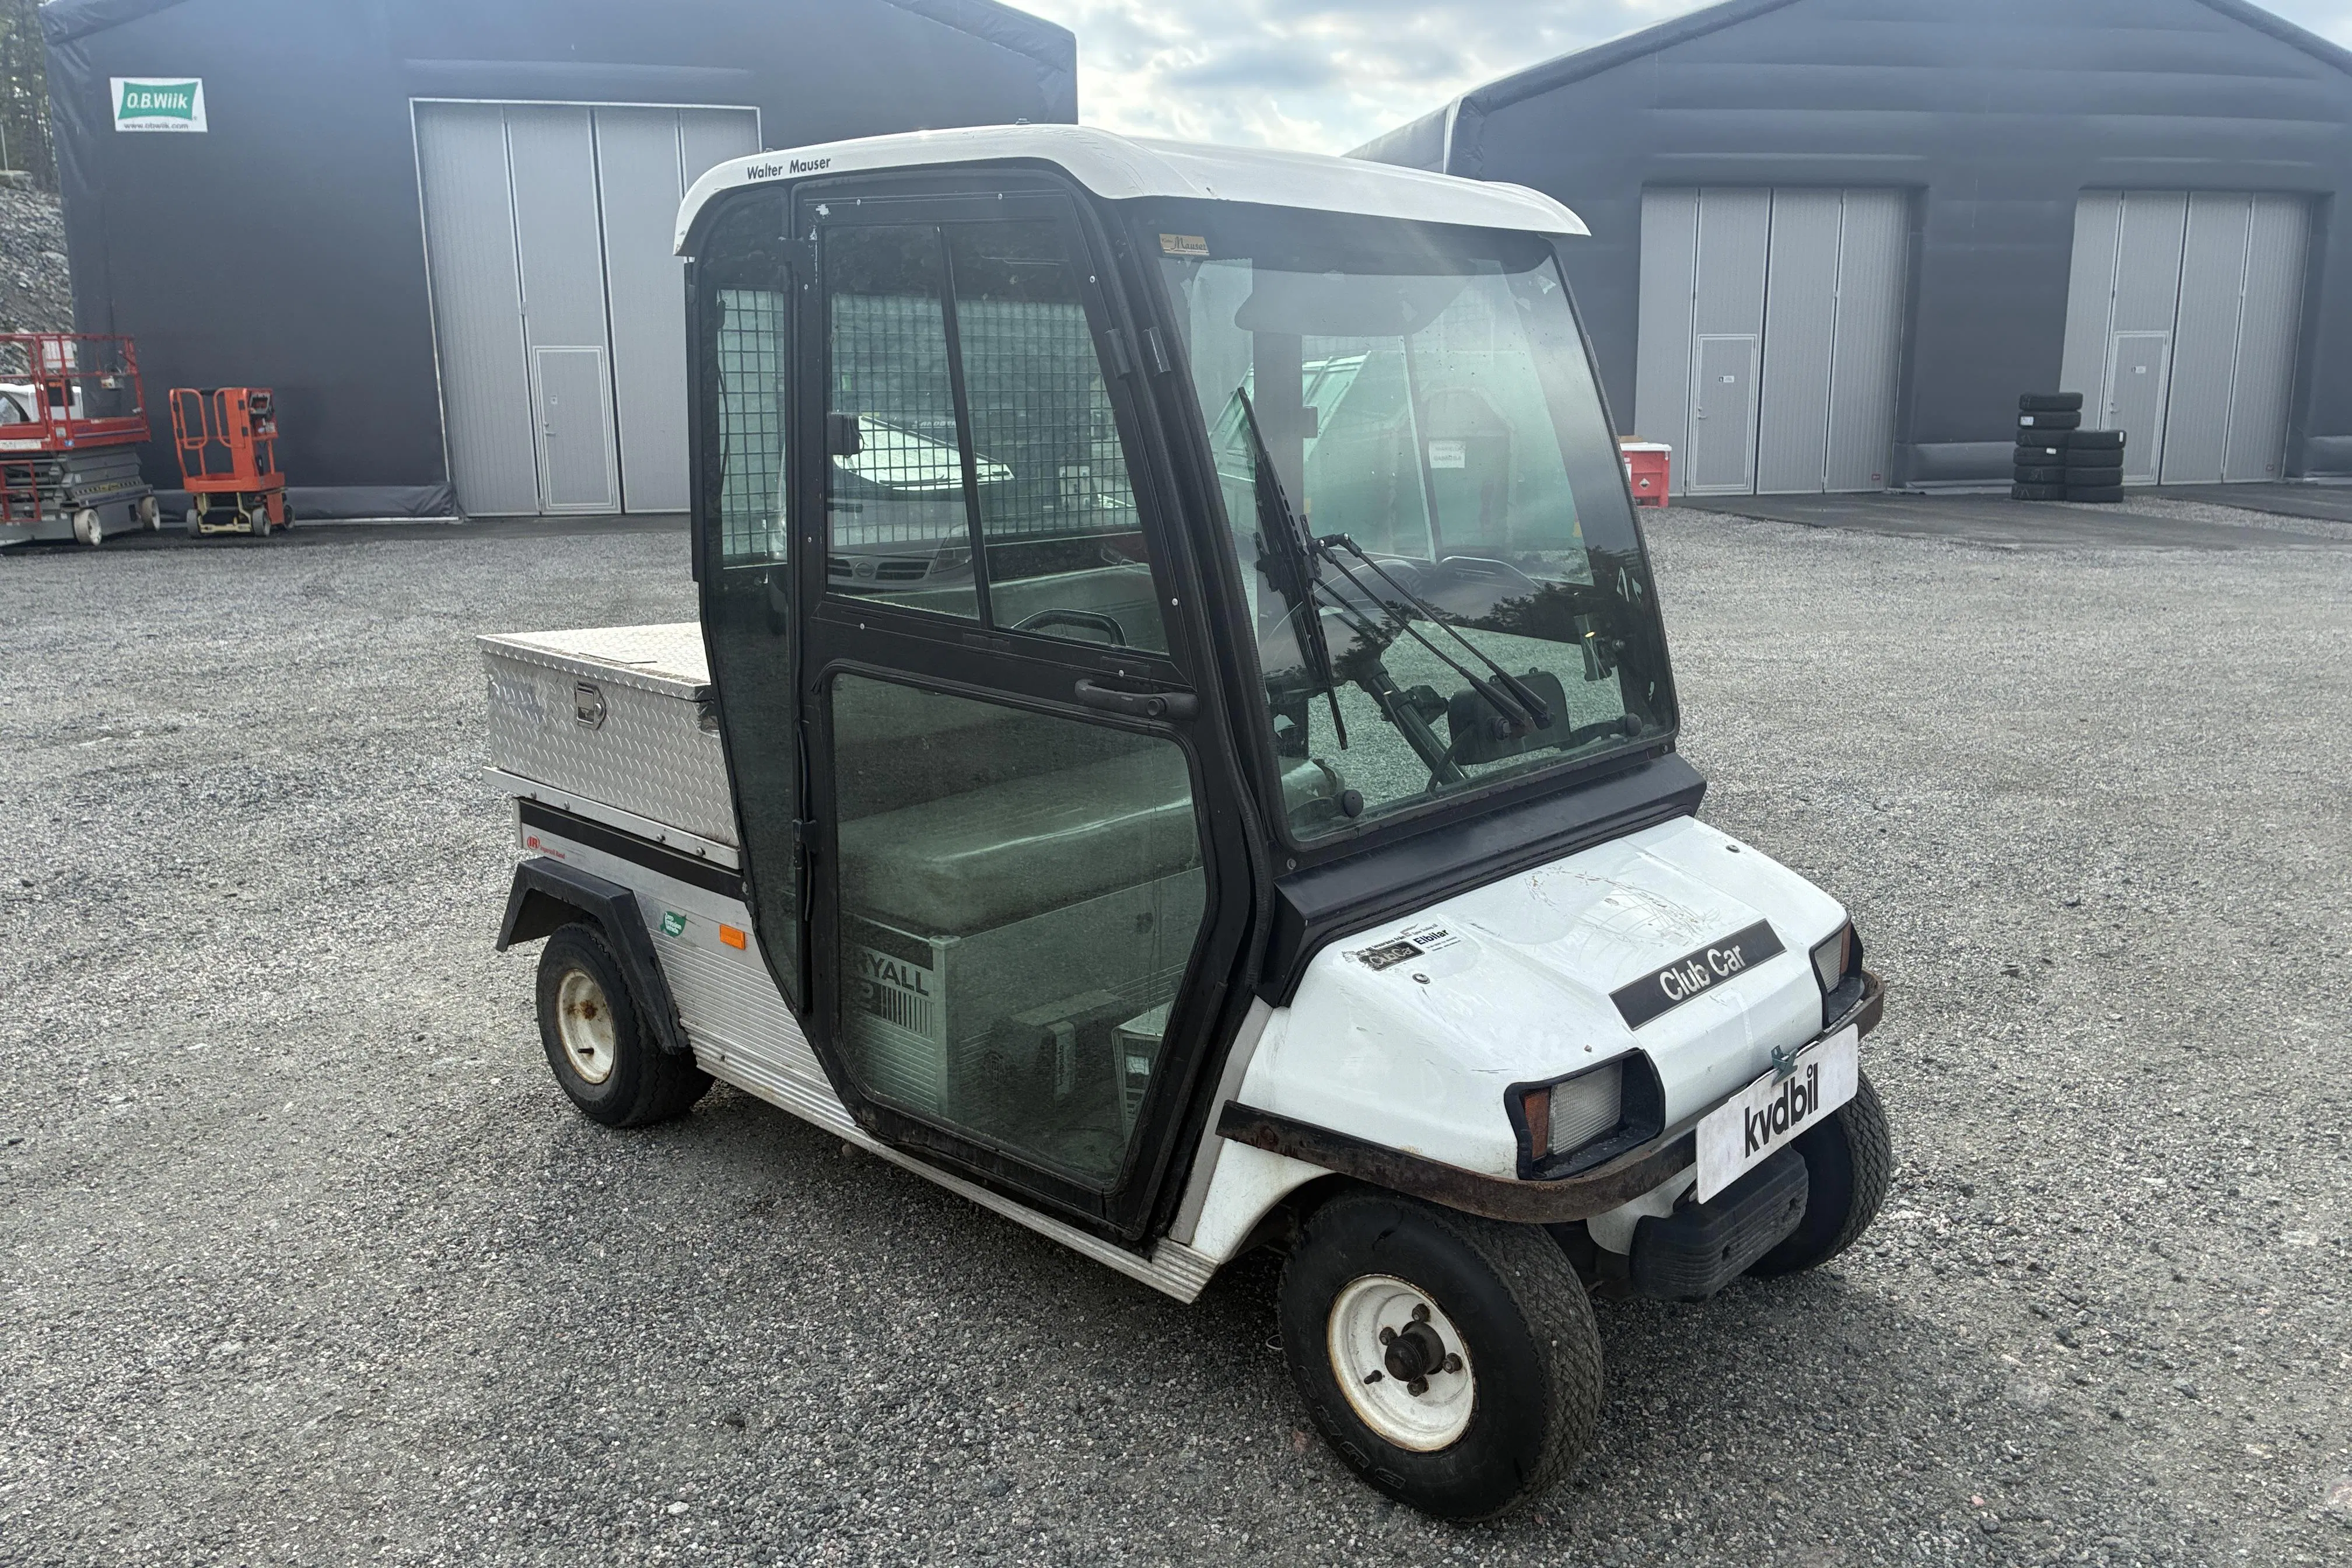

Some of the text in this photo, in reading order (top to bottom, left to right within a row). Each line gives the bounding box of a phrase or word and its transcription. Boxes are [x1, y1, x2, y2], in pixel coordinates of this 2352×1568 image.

[127, 92, 188, 109] O.B.Wiik
[747, 158, 831, 180] Walter Mauser
[1170, 236, 1207, 251] Mauser
[1413, 929, 1449, 945] Elbilar
[1660, 944, 1746, 1001] Club Car
[1745, 1062, 1819, 1159] kvdbil
